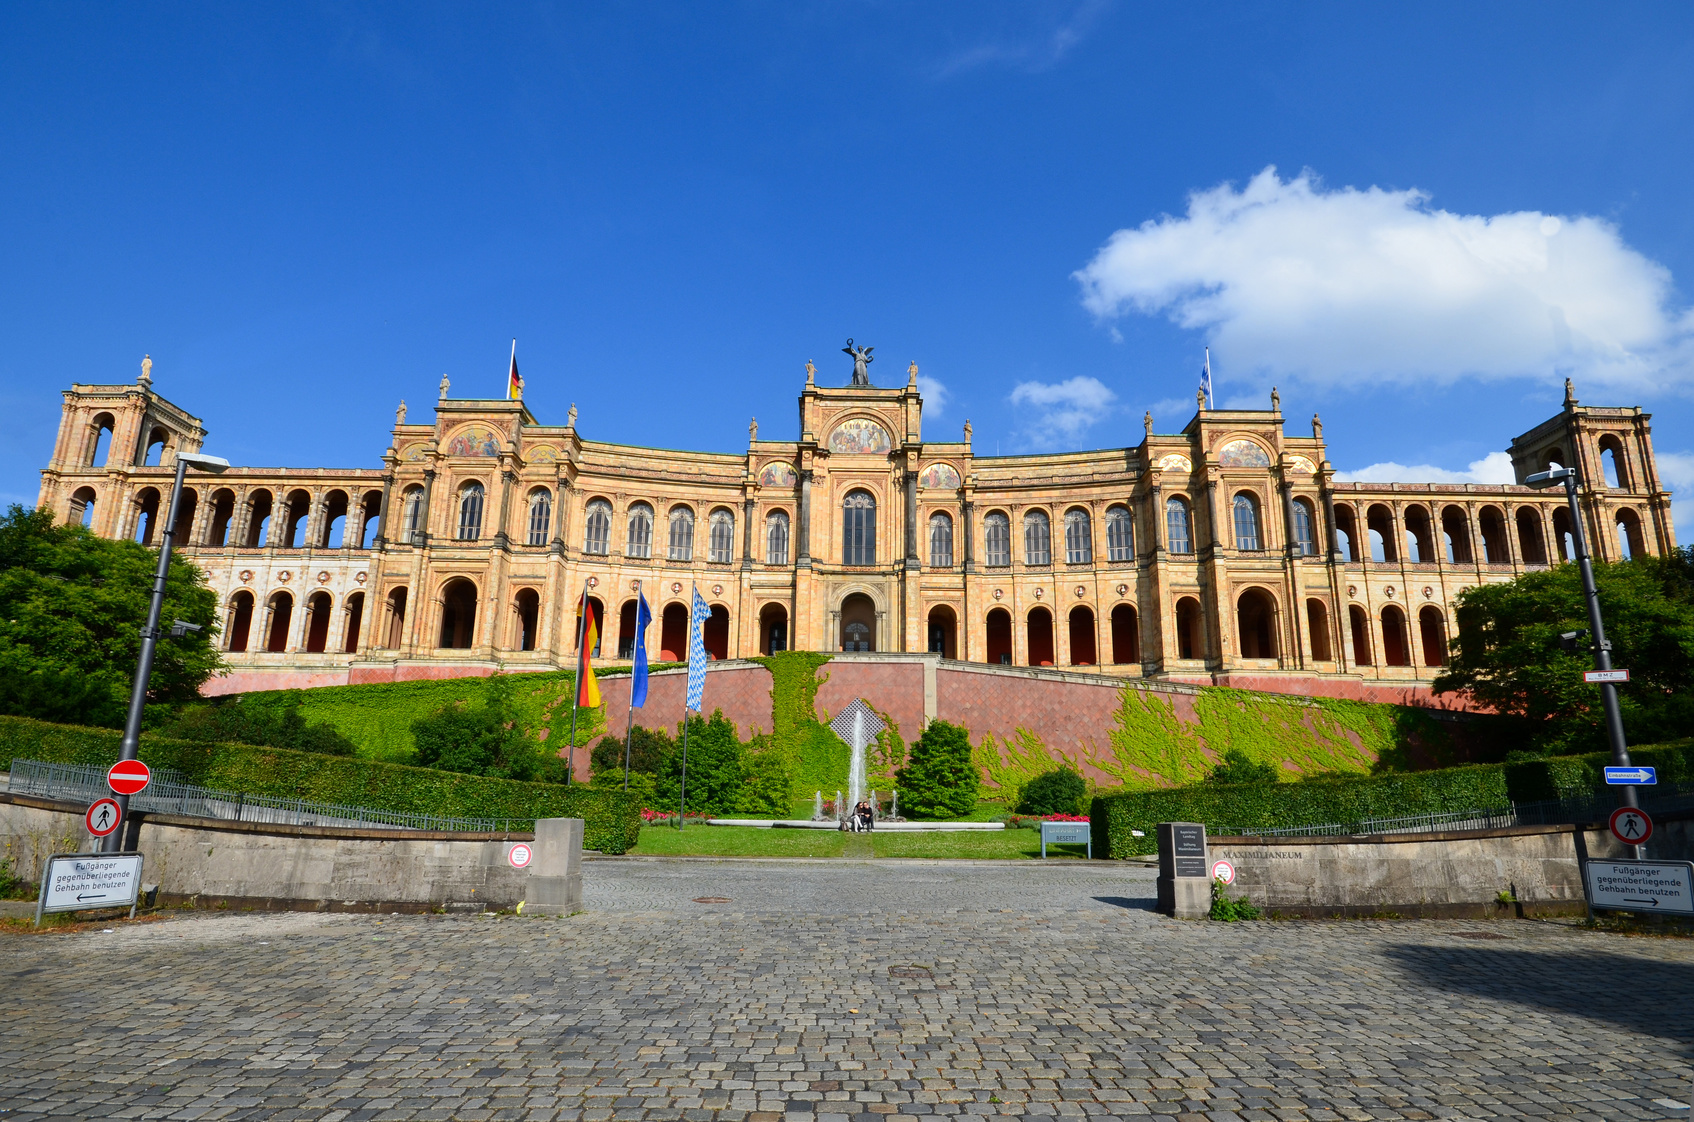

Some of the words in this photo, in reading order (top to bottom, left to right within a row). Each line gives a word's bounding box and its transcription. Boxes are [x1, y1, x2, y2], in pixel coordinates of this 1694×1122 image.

[1223, 851, 1302, 859] MAXIMILIANEUM
[75, 861, 117, 871] Fußgänger
[1612, 866, 1661, 877] Fußgänger
[56, 870, 131, 884] gegenüberliegende
[1597, 876, 1682, 888] gegenüberliegende
[55, 882, 90, 892] Gehbahn
[92, 881, 126, 890] benutzen
[1598, 884, 1637, 894] Gehbahn
[1638, 886, 1681, 897] benutzen
